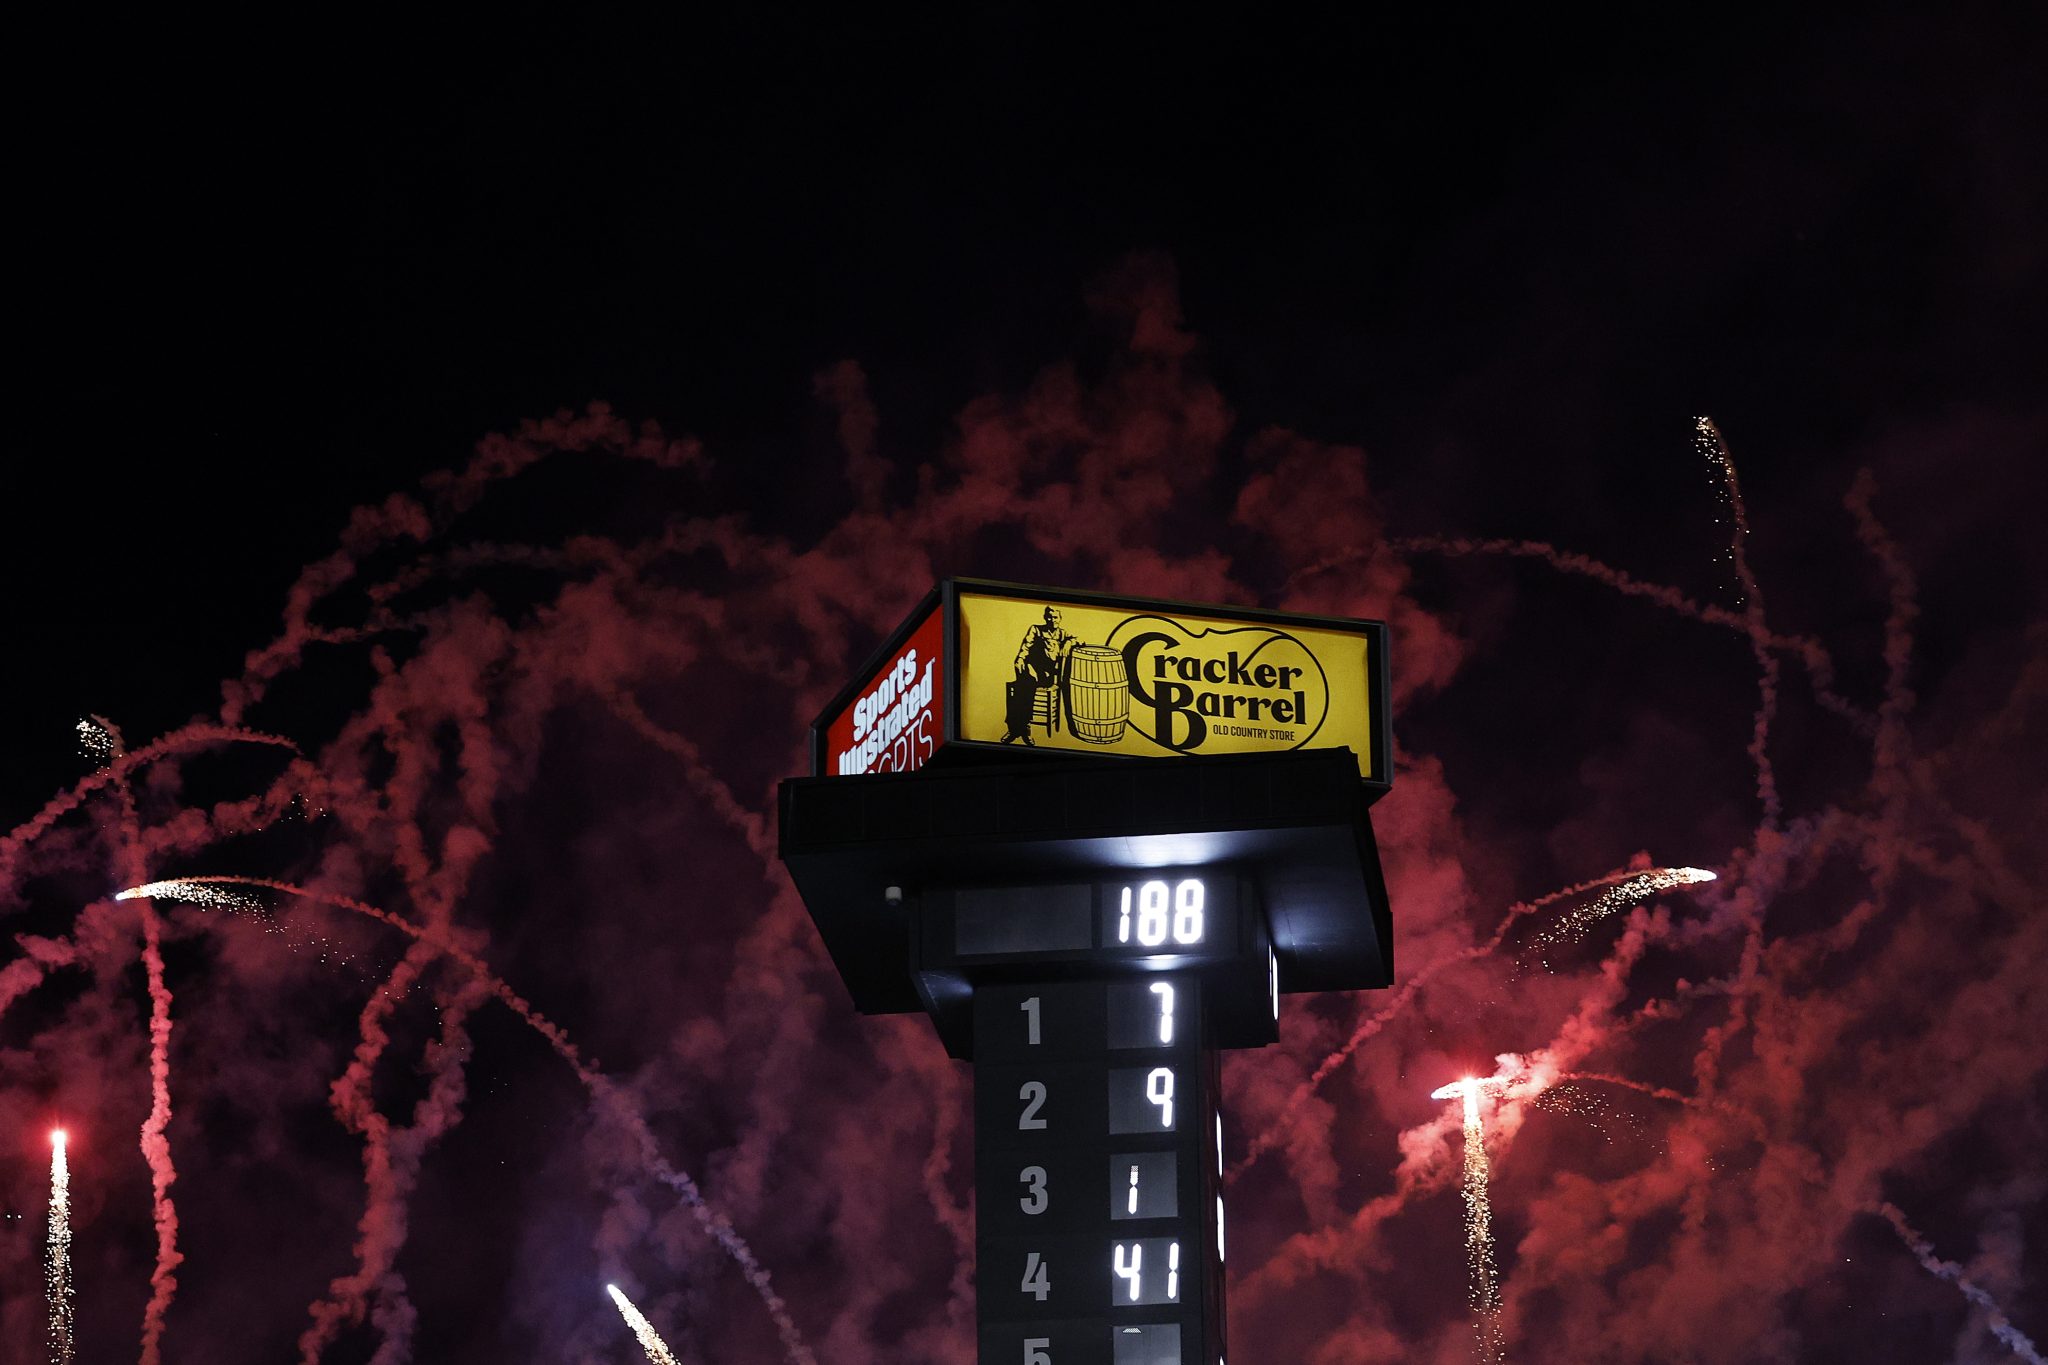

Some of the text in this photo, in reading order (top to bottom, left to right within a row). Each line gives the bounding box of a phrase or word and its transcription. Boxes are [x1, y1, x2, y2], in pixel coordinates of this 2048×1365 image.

[853, 648, 918, 742] Sports
[1122, 631, 1303, 709] Cracker
[838, 662, 934, 776] Illustrated
[1153, 680, 1307, 751] Barrel
[1213, 724, 1295, 741] OLD COUNTRY STORE
[1118, 879, 1205, 948] 188
[1020, 997, 1041, 1045] 1
[1149, 982, 1174, 1044] 7
[1018, 1081, 1047, 1130] 2
[1146, 1067, 1174, 1128] 9
[1020, 1165, 1048, 1215] 3
[1021, 1252, 1051, 1301] 4
[1113, 1242, 1179, 1302] 41
[1023, 1337, 1051, 1365] 5
